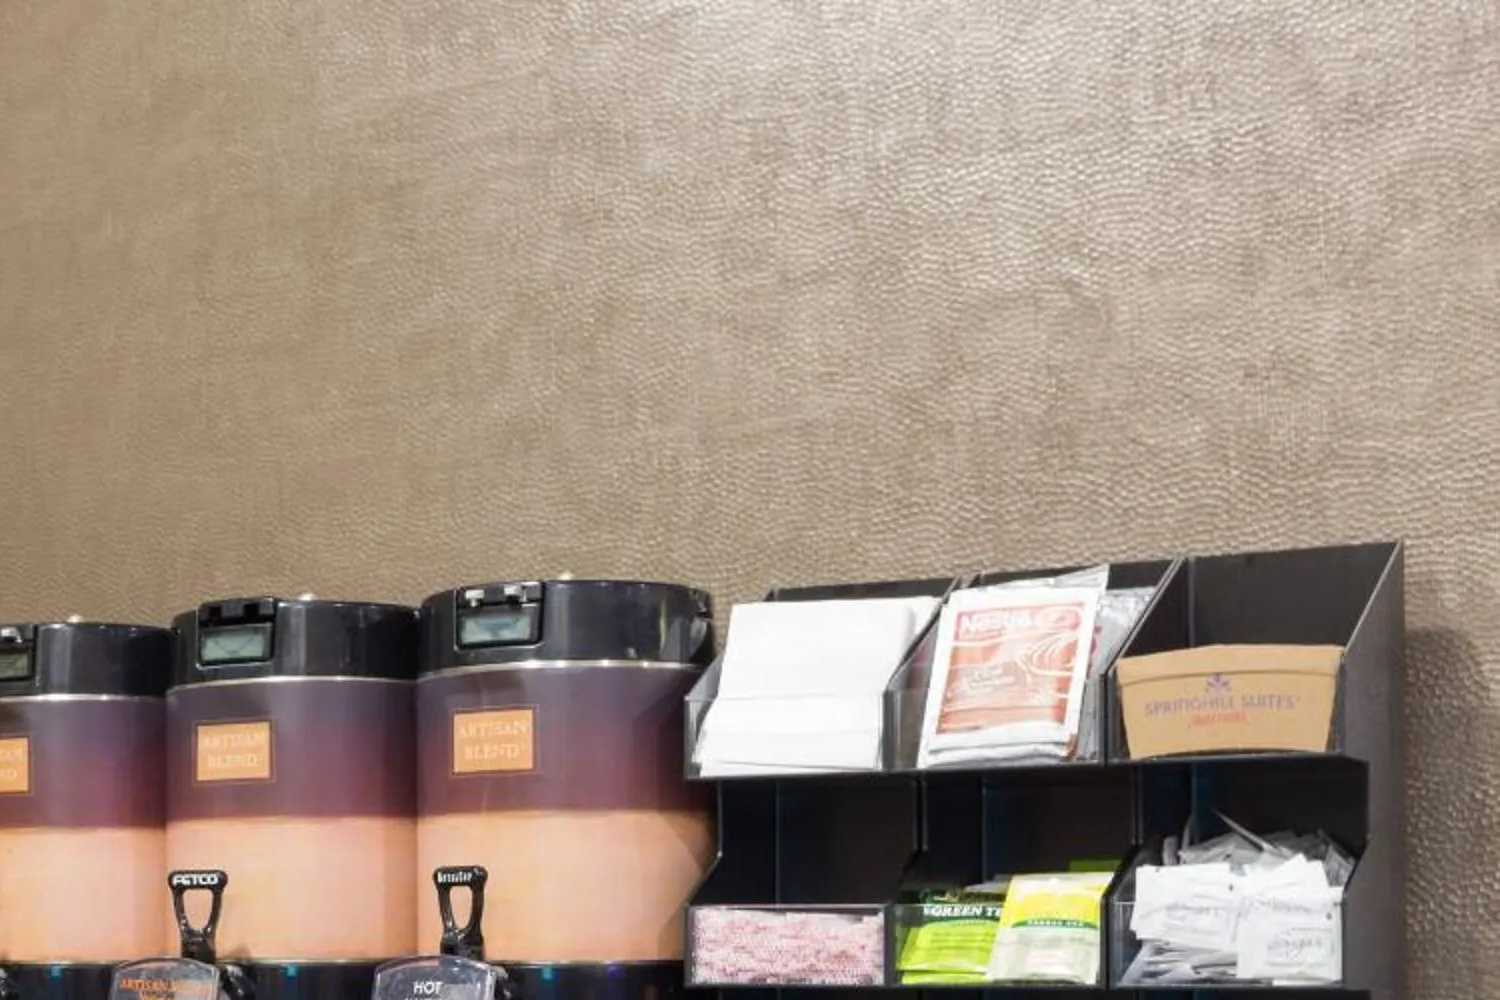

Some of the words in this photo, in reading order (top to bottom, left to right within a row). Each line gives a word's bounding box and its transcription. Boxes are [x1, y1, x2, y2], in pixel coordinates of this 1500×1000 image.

[458, 719, 528, 738] ARTISAN
[464, 743, 519, 761] BLEND
[207, 753, 258, 769] BLEND
[412, 980, 443, 995] HOT
